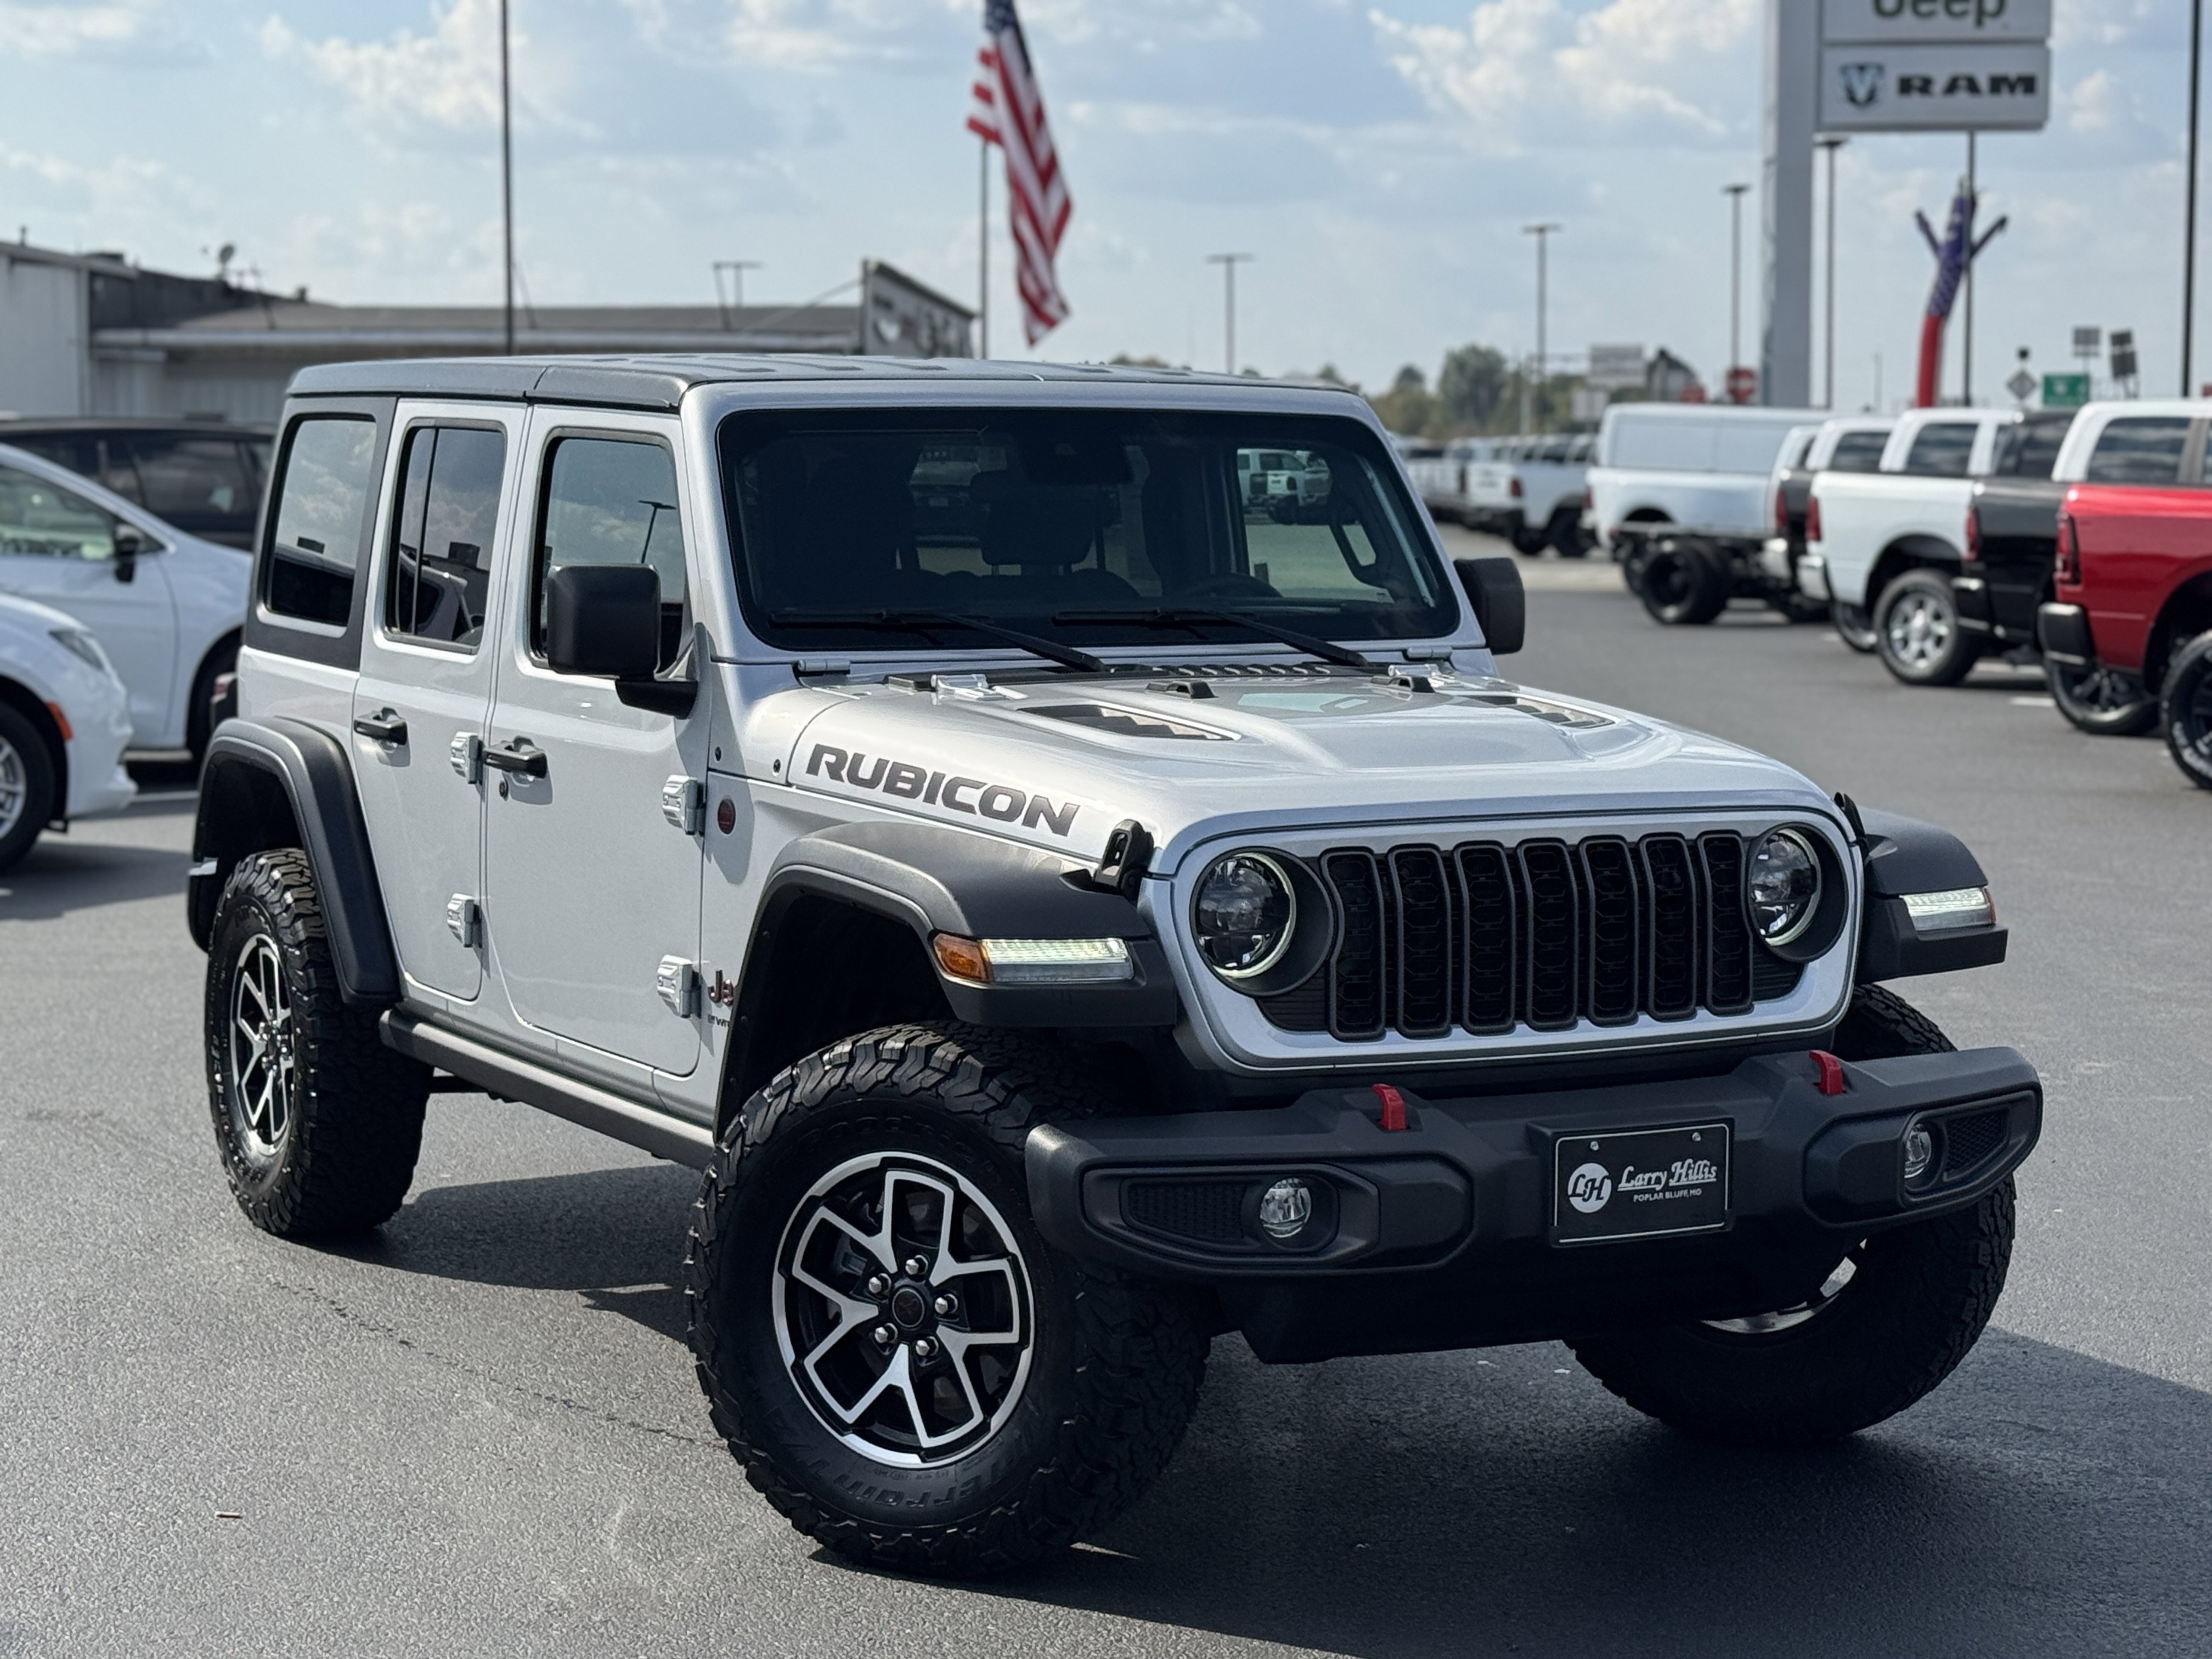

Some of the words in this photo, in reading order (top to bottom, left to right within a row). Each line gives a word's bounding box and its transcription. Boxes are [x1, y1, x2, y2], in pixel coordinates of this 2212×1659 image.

[1898, 75, 2036, 95] RAM
[805, 743, 1080, 837] RUBICON
[1569, 1173, 1611, 1203] LH
[1617, 1166, 1667, 1191] Larry
[1669, 1159, 1717, 1186] Hillis
[1633, 1192, 1663, 1202] POPLAR
[1690, 1188, 1702, 1197] MO
